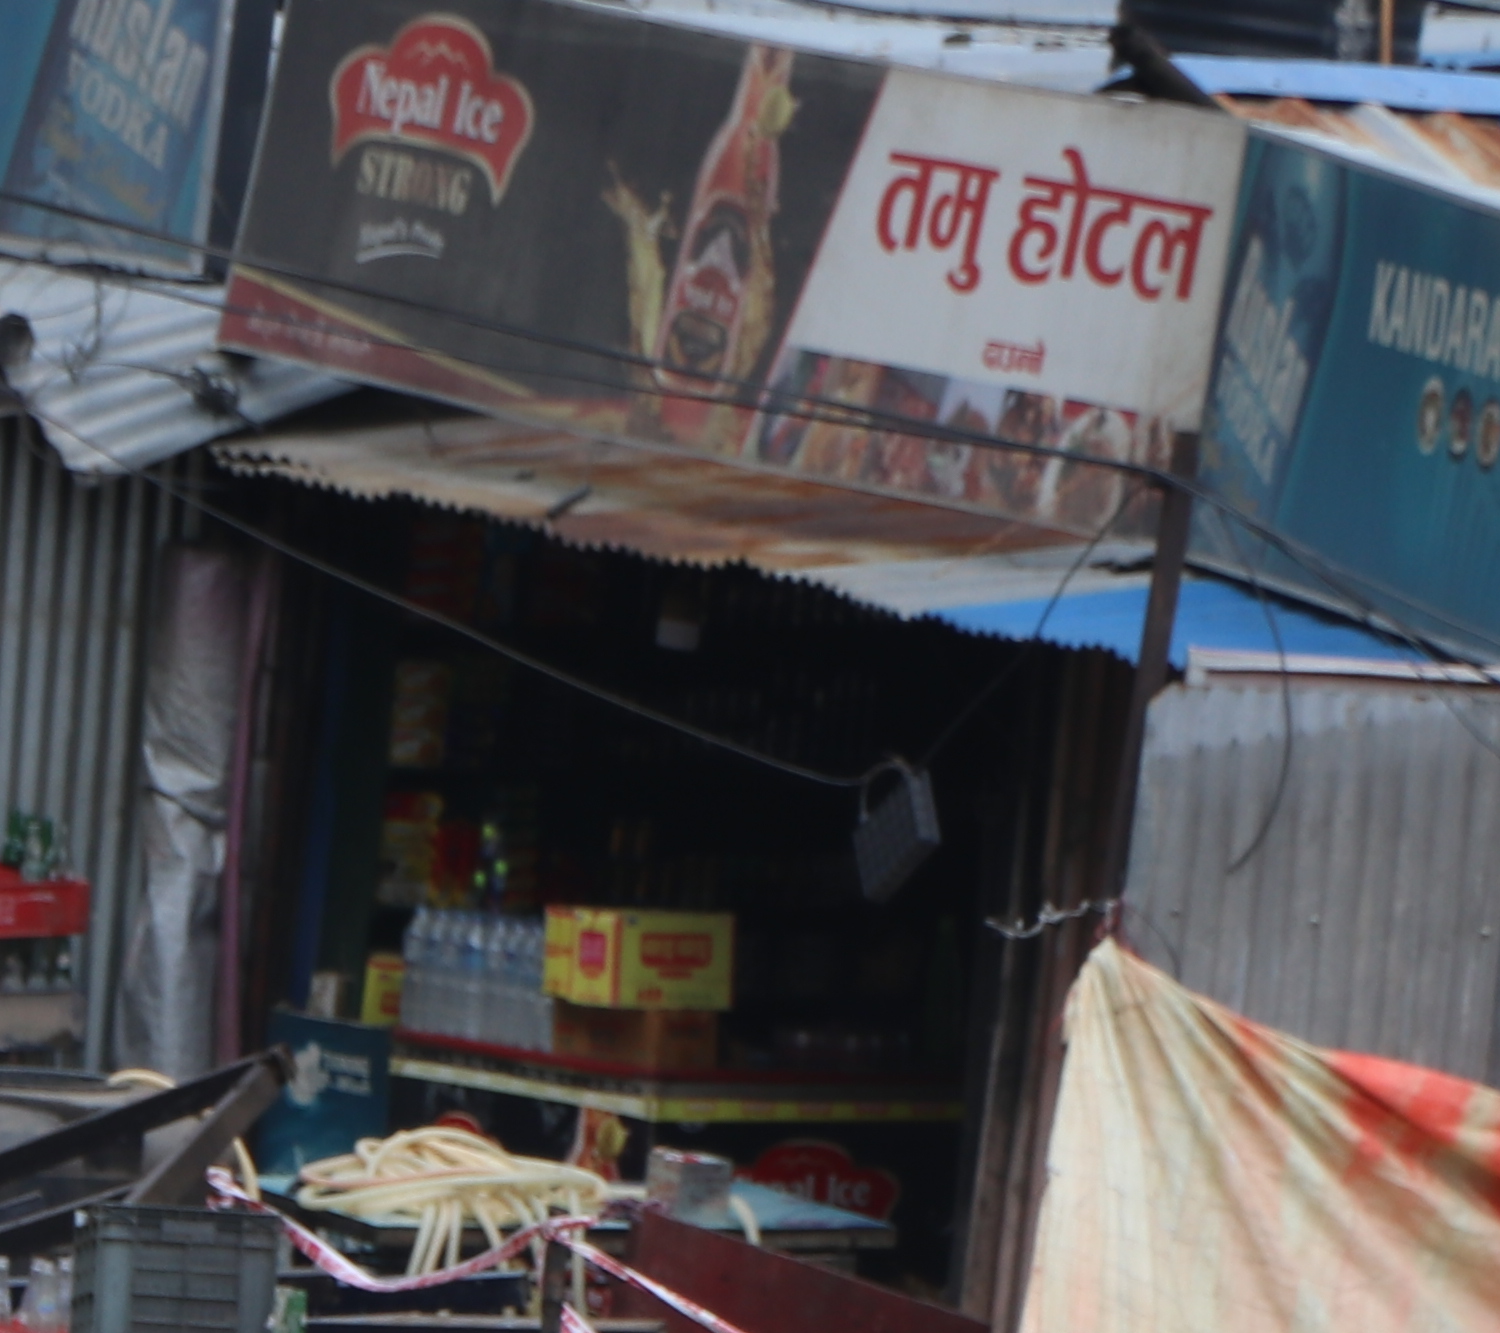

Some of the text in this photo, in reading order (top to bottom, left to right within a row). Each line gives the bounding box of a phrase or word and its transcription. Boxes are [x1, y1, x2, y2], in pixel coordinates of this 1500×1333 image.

[356, 60, 505, 144] Nepal Ice
[356, 146, 472, 216] STRONG
[876, 146, 1214, 302] तमु होटल
